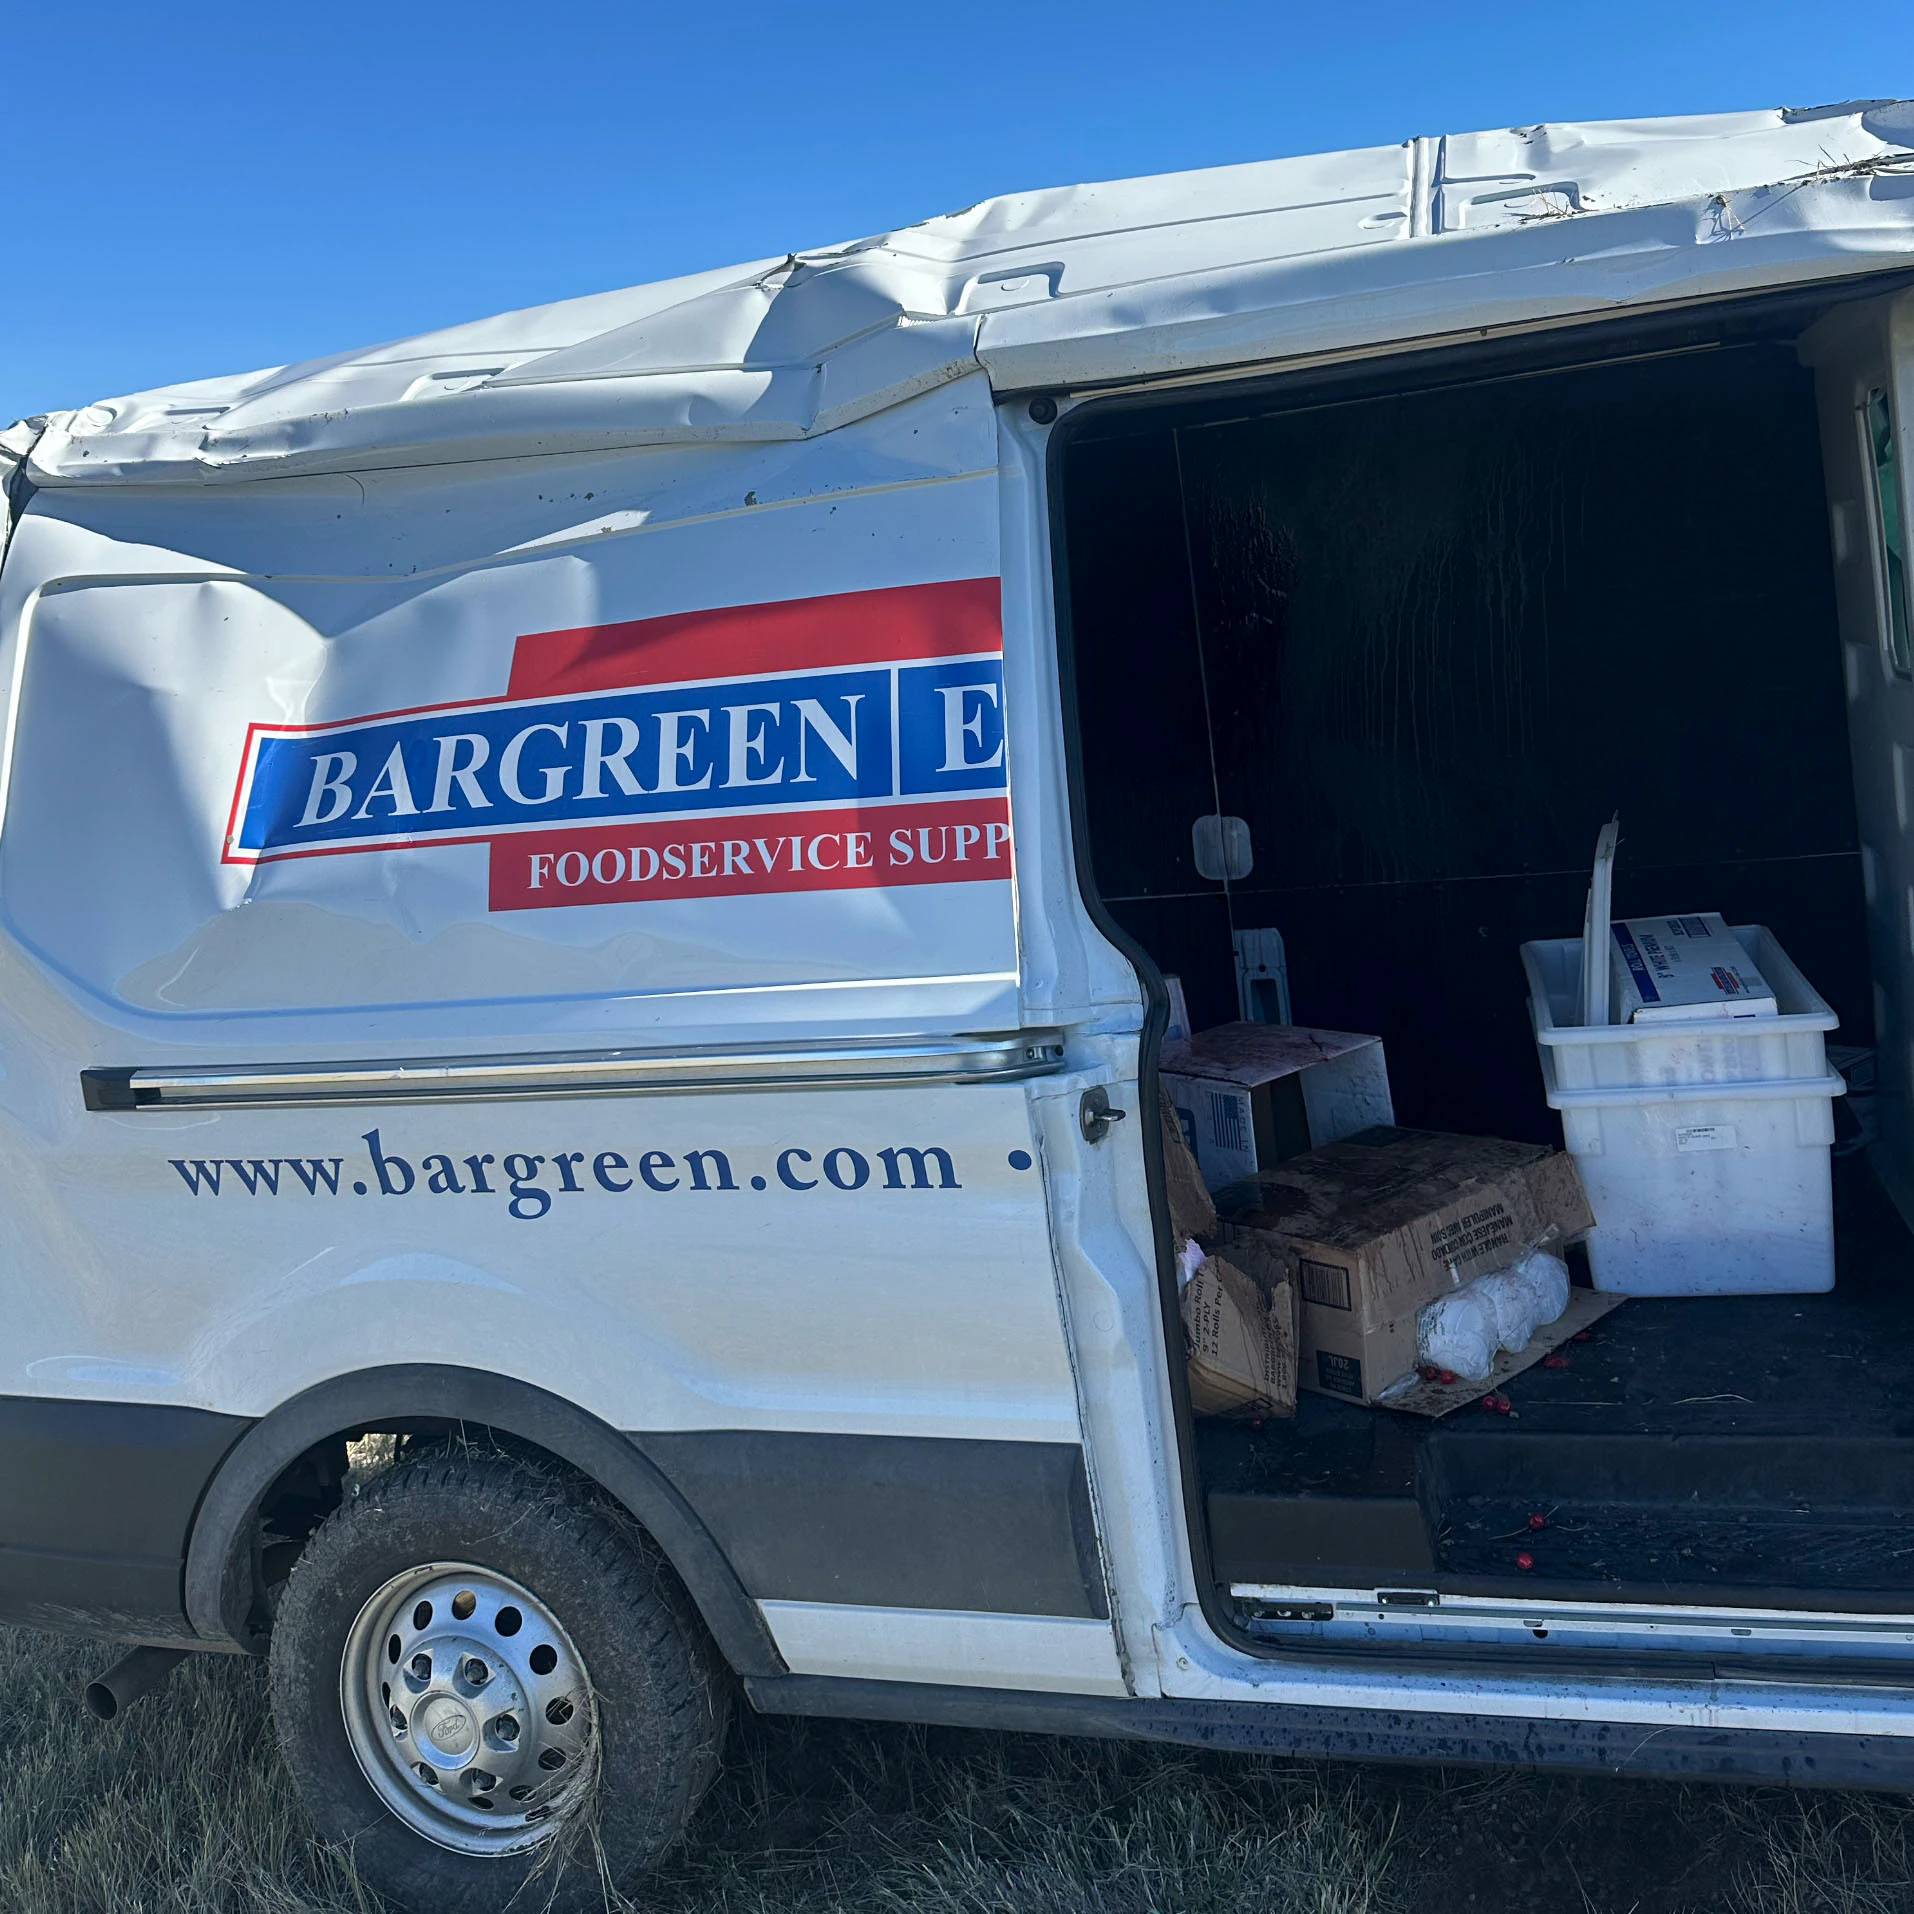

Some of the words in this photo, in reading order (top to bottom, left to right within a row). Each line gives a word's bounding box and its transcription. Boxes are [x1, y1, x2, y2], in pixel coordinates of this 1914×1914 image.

[295, 694, 865, 828] BARGREEN
[934, 683, 1004, 773] E
[528, 832, 874, 889] FOODSERVICE
[889, 822, 1011, 866] SUPP
[1238, 1096, 1247, 1132] MADE
[1240, 1140, 1249, 1152] IN
[167, 1128, 963, 1220] www.bargreen.com
[1463, 1203, 1504, 1229] MANIPULER
[1461, 1245, 1479, 1262] WITH
[1478, 1233, 1509, 1254] HANDLE
[1195, 1281, 1204, 1305] Roll
[1214, 1287, 1223, 1307] Per
[1192, 1305, 1202, 1349] Jumbo
[1212, 1310, 1221, 1339] Rolls
[1211, 1341, 1218, 1357] 12
[438, 1718, 460, 1738] Ford
